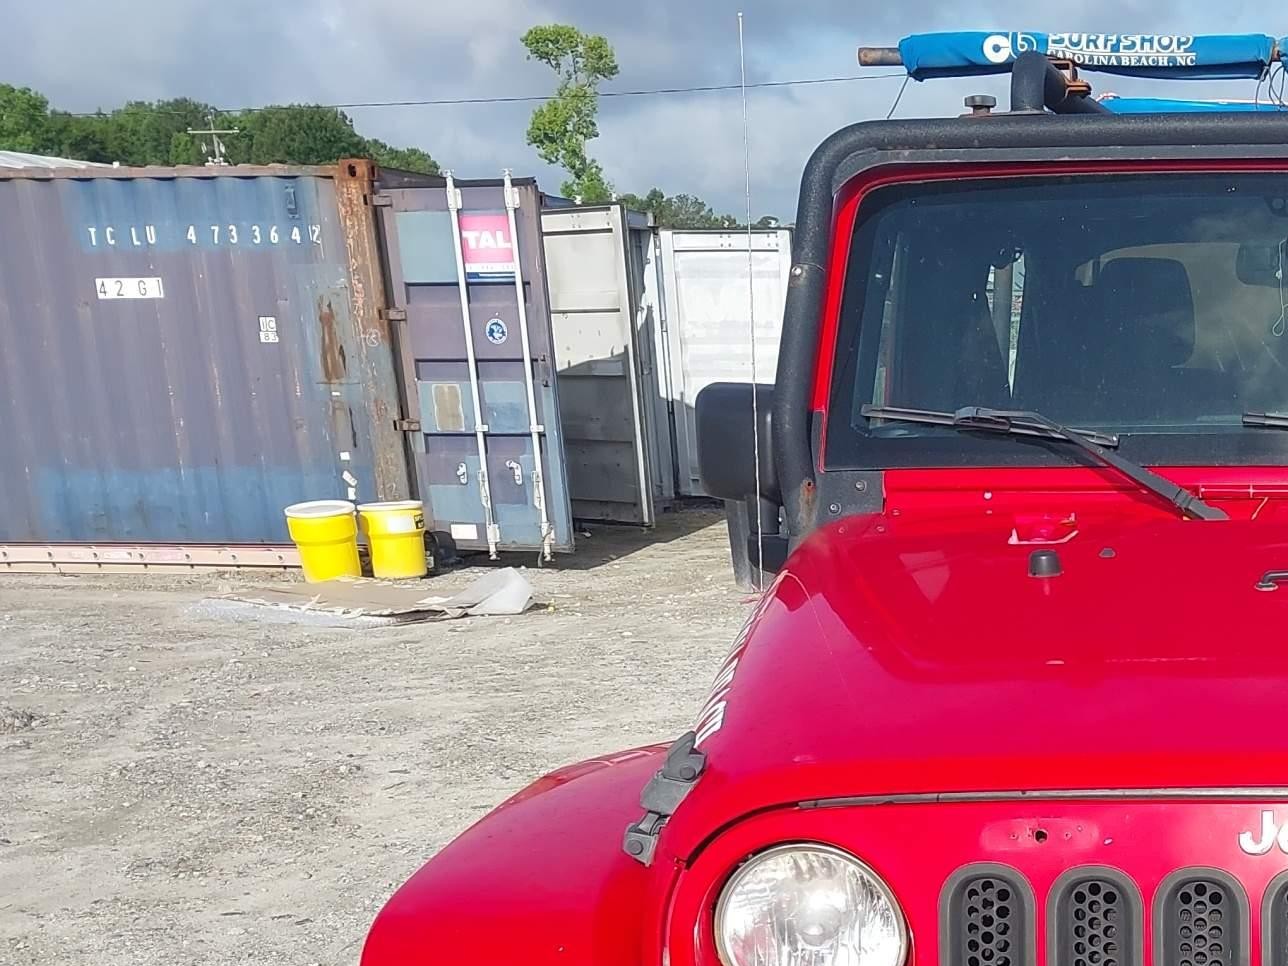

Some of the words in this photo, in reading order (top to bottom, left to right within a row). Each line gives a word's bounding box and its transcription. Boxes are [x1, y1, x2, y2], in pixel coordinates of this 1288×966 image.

[1047, 33, 1117, 52] SURF
[1119, 34, 1193, 53] SHOP
[1046, 49, 1119, 66] CAROLINA
[1176, 56, 1196, 66] NC
[461, 230, 513, 249] TAL
